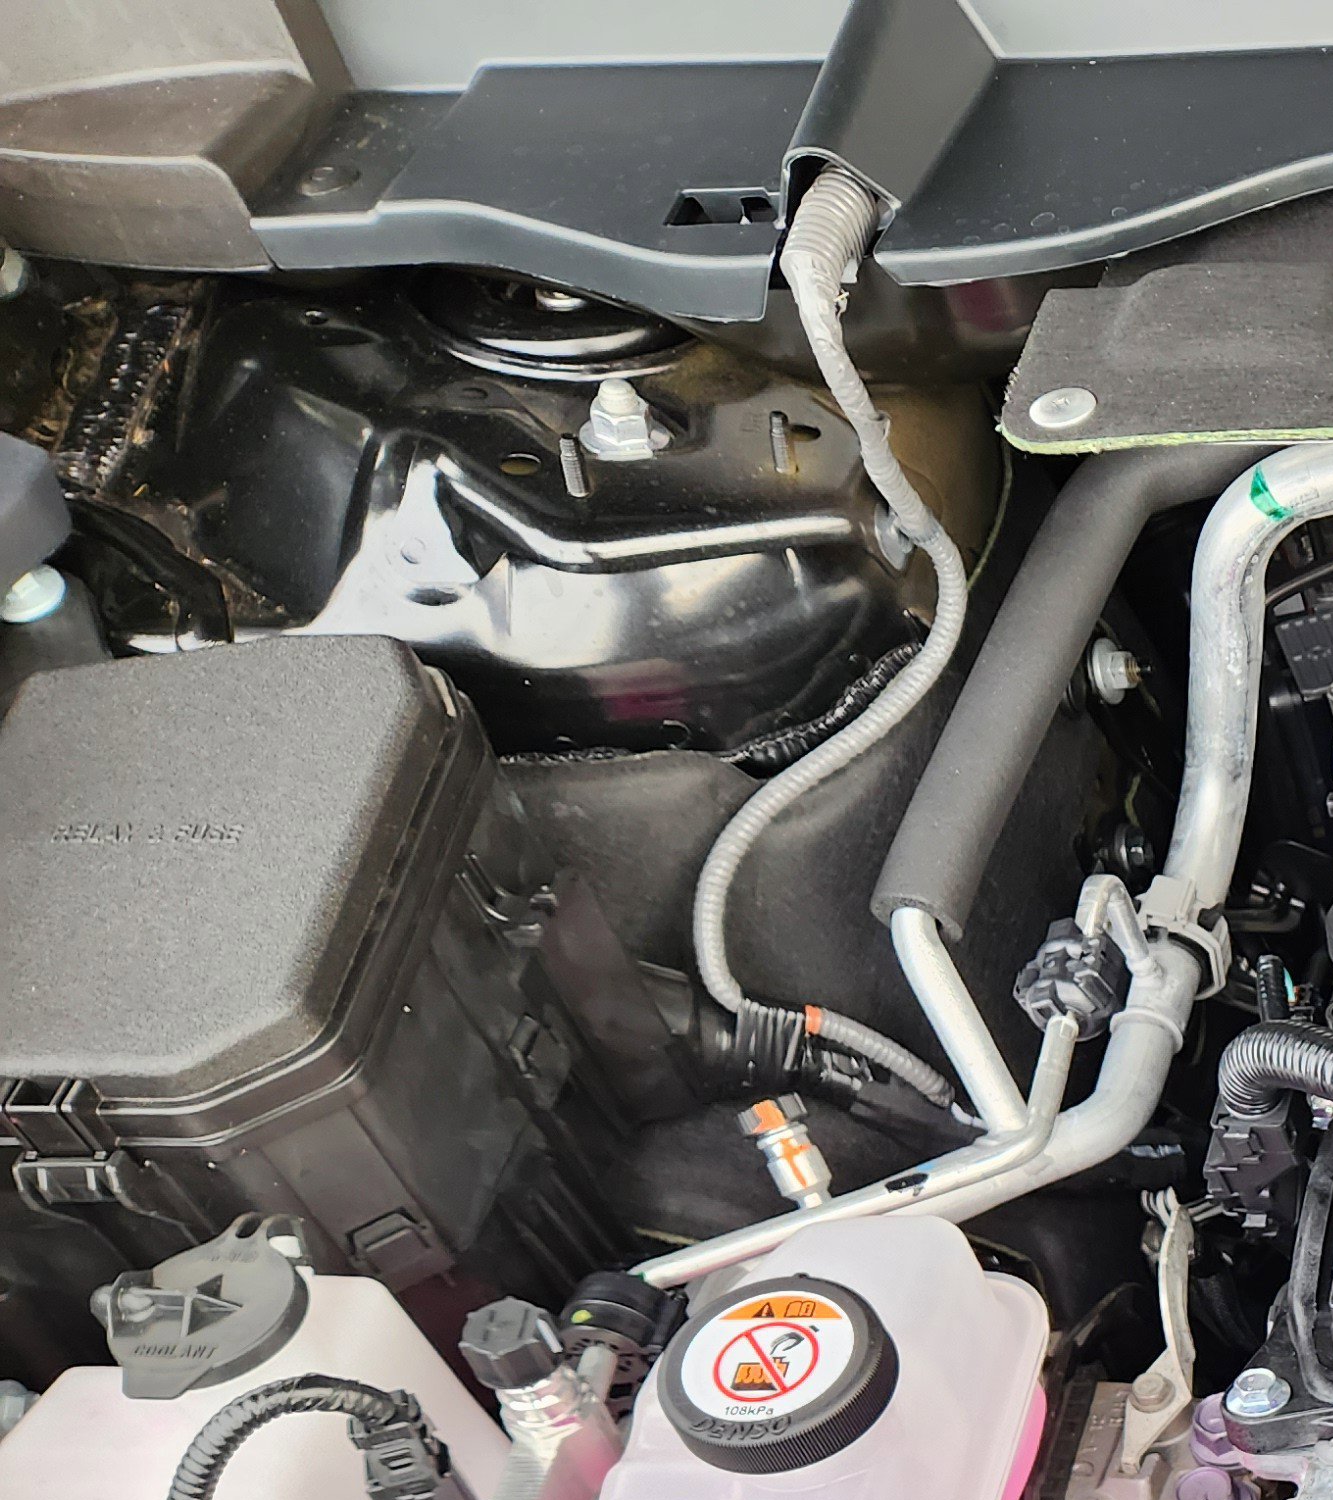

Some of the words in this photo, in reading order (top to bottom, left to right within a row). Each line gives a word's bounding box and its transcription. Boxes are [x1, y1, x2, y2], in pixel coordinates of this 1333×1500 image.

[51, 822, 133, 845] RELAY
[173, 822, 246, 845] FUSE
[131, 1342, 219, 1360] COOLANT
[723, 1405, 775, 1417] 108kPa
[689, 1414, 793, 1442] DENSO
